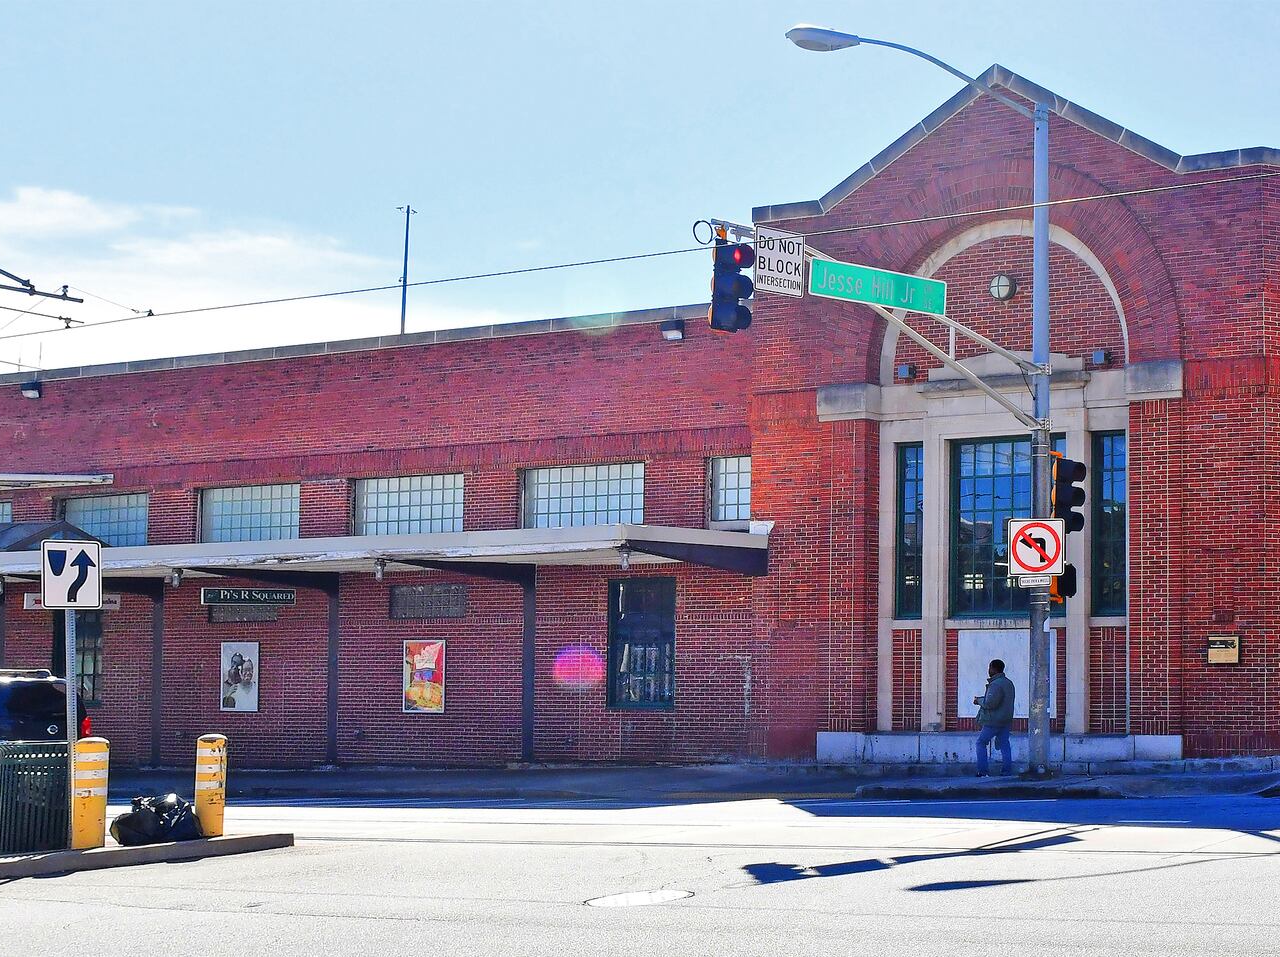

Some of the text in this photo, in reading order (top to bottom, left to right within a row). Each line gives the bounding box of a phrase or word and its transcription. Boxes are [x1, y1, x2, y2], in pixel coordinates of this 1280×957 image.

[758, 235, 802, 256] DO NOT
[758, 256, 801, 277] BLOCK
[757, 276, 801, 291] INTERSECTION
[817, 267, 916, 304] Jesse Hill Jr
[241, 590, 249, 599] R
